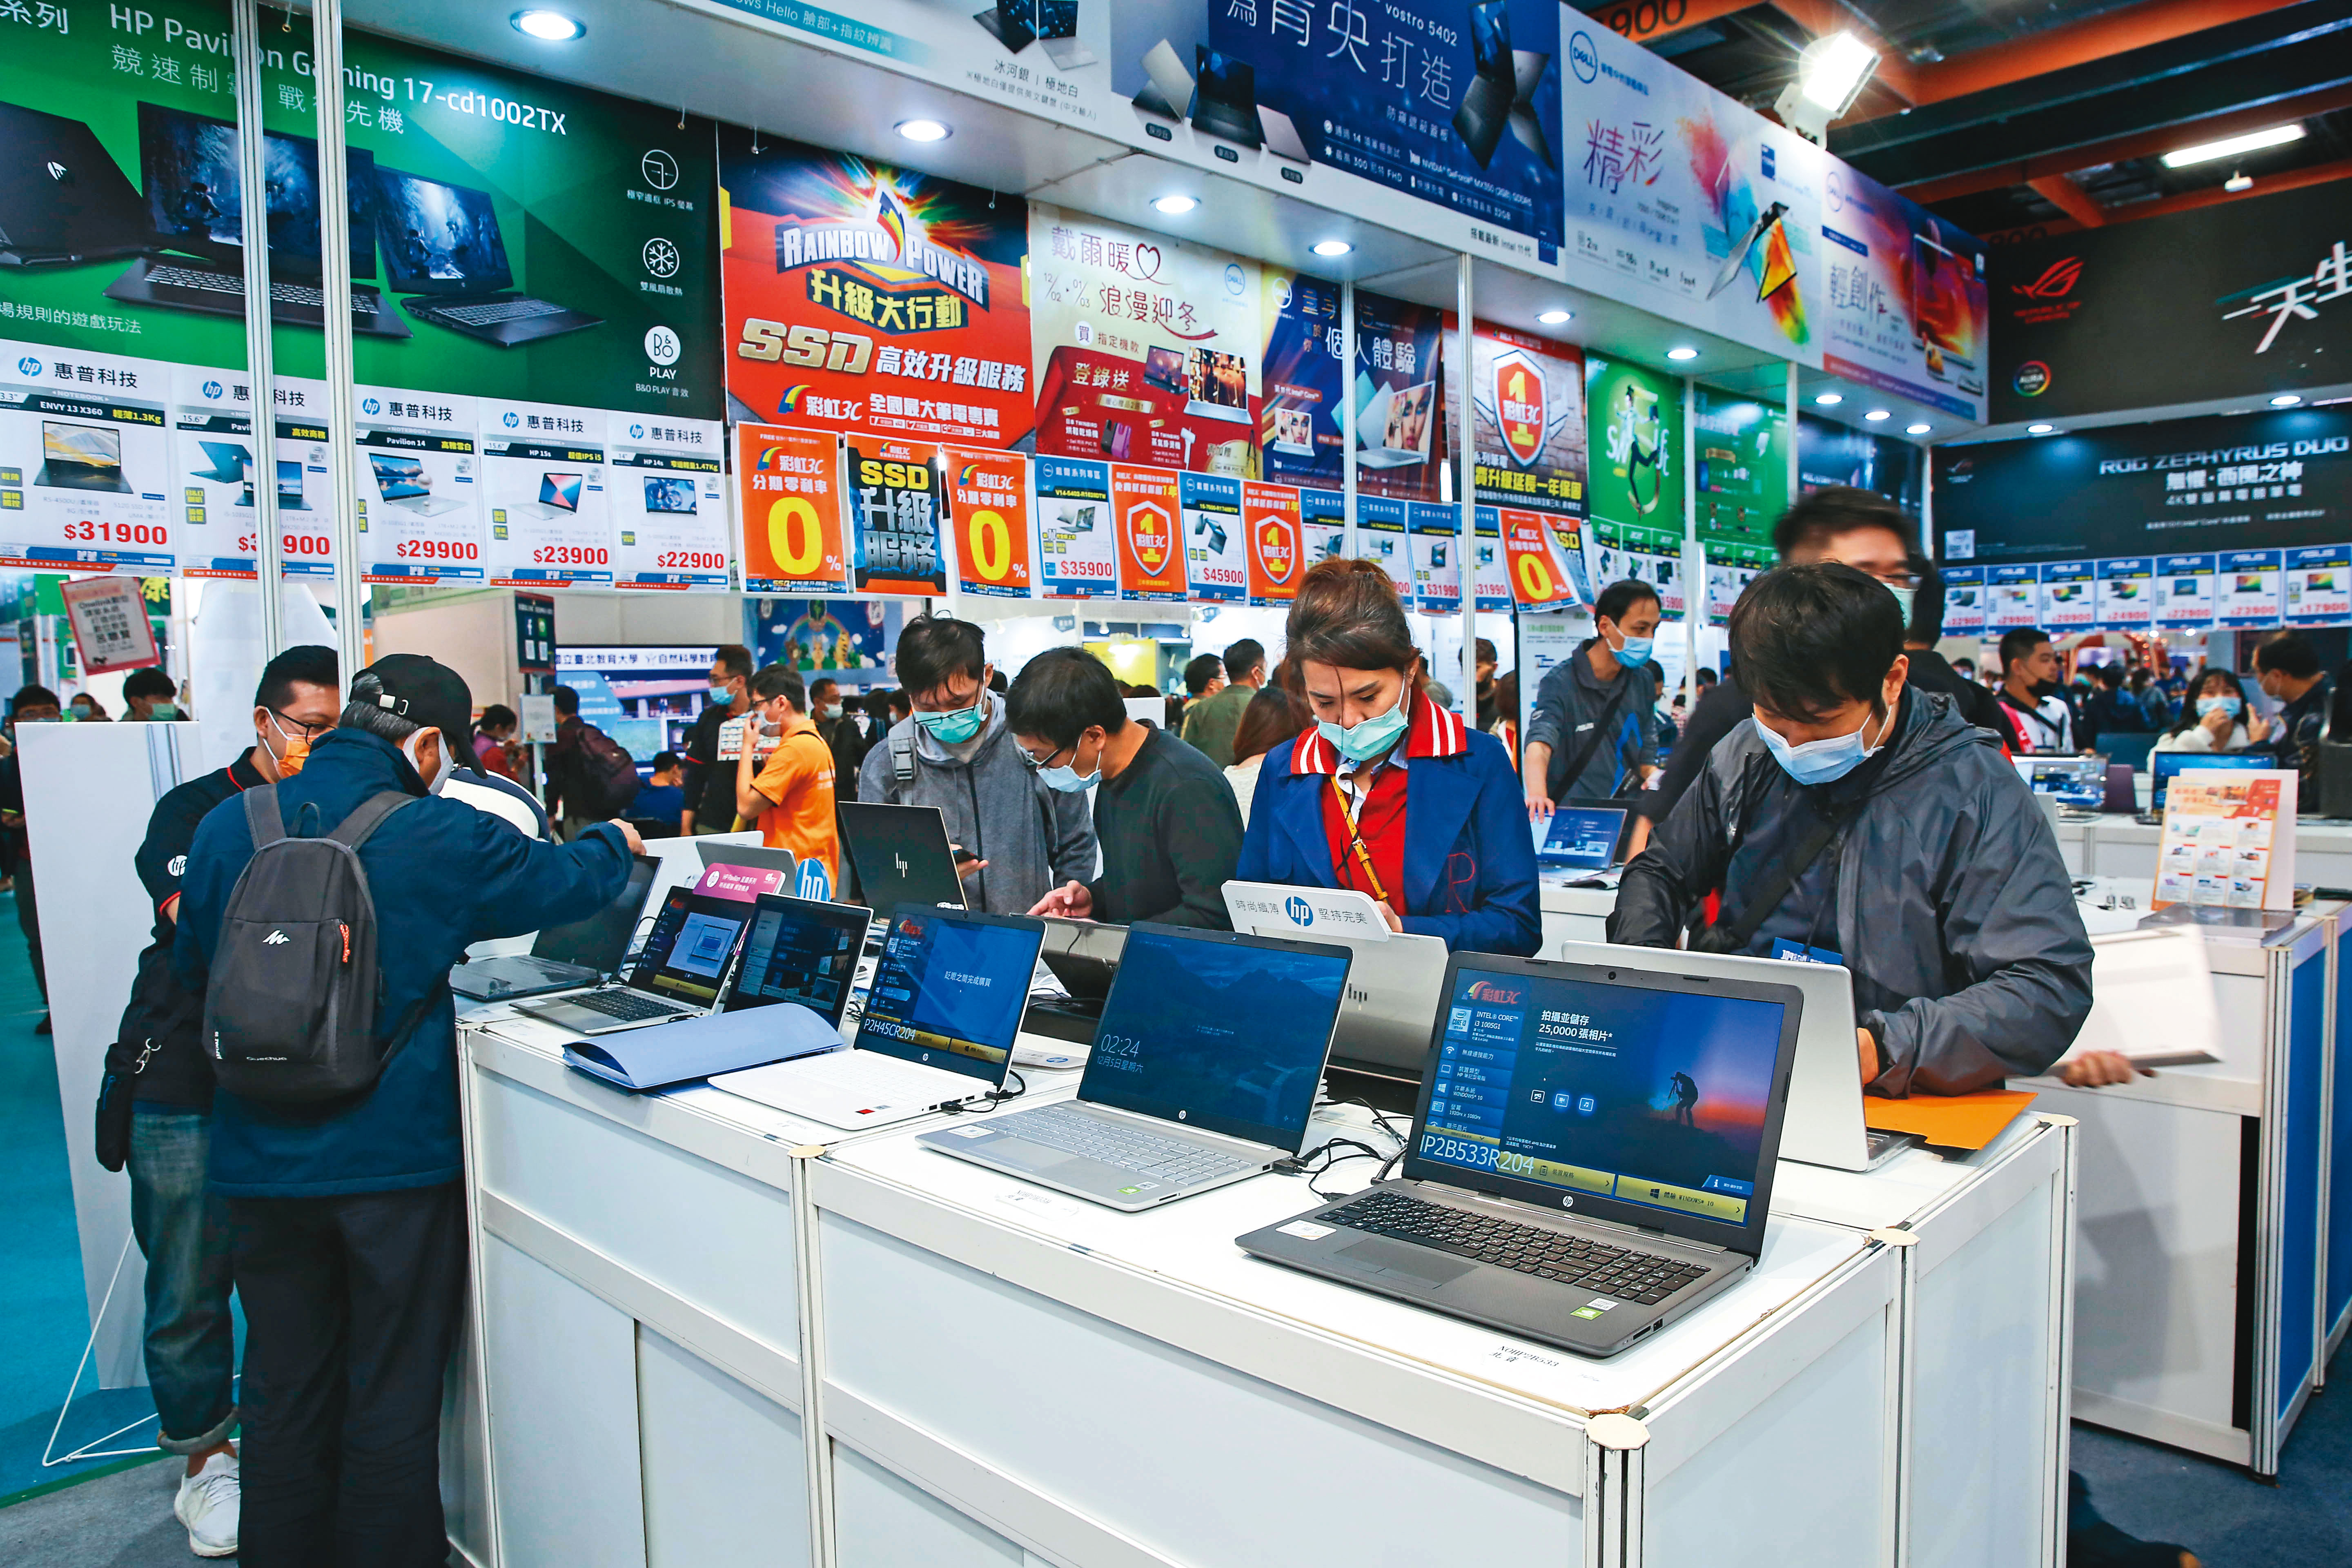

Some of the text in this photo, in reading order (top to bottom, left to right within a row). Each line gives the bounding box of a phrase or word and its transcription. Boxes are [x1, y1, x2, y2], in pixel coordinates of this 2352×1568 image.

[766, 0, 798, 20] Hello
[1429, 21, 1457, 46] 5402
[110, 3, 154, 35] HP
[164, 17, 283, 69] Pavilon
[403, 77, 567, 136] 17-cd1002TX
[995, 59, 1079, 98] 冰河銀 極地白
[279, 84, 403, 135] 戰先機
[1583, 119, 1664, 194] 精彩
[664, 198, 676, 207] IPS
[782, 226, 983, 305] RAINBOW POWER
[810, 267, 962, 330] 升級大行動
[1099, 281, 1197, 331] 浪漫迎冬
[1098, 332, 1139, 354] 指定機款
[737, 317, 1027, 394] SSD 高效升級服務
[18, 357, 138, 389] hp 惠普科技
[650, 366, 677, 380] PLAY
[1072, 362, 1130, 392] 登錄送
[203, 381, 305, 408] hp 惠科技
[635, 383, 689, 398] B&O PLAY 音效
[40, 401, 65, 411] ENVY
[80, 406, 103, 416] X360
[363, 398, 453, 421] hp 惠普科技
[806, 395, 864, 421] 彩虹3C
[869, 392, 999, 428] 全國最大筆電專賣
[503, 412, 584, 433] hp 惠普科技
[386, 437, 416, 446] Pavilion
[630, 424, 703, 444] hp 惠普科技
[779, 453, 824, 475] 彩虹3C
[2099, 436, 2350, 476] ROG ZEPHYRUS DUO
[752, 474, 828, 495] 分期零利率
[860, 459, 929, 491] SSD
[976, 470, 1015, 490] 彩虹3C
[956, 488, 1018, 509] 分期零利率
[859, 487, 933, 535] 升級
[64, 520, 167, 545] $31900
[768, 497, 842, 575] 0 %
[238, 533, 330, 555] $900
[397, 539, 478, 560] $29900
[533, 545, 608, 565] $23900
[865, 531, 936, 576] 服務
[968, 510, 1027, 581] 0 %
[657, 551, 724, 570] $22900
[1061, 560, 1112, 577] $35900
[1203, 567, 1244, 584] $45900
[1517, 553, 1553, 600] 0
[1426, 584, 1459, 598] $31990
[555, 654, 638, 664] 國立臺北教育大學
[1235, 896, 1368, 927] 時尚纖薄 hp 堅持完美
[944, 971, 992, 988] 眨眼之間完成購買
[1481, 988, 1521, 1004] 彩虹3C
[1541, 1010, 1590, 1026] 拍攝並儲存
[863, 1018, 916, 1041] P2H45CR204
[1539, 1024, 1577, 1037] 25,0000
[1100, 1033, 1141, 1058] 02:24
[1462, 1049, 1494, 1060] 無線連接能力
[1097, 1056, 1144, 1074] 12月5日星期六
[1455, 1085, 1476, 1094] 作業系統
[1178, 1109, 1187, 1120] hp
[1562, 1195, 1574, 1208] hp
